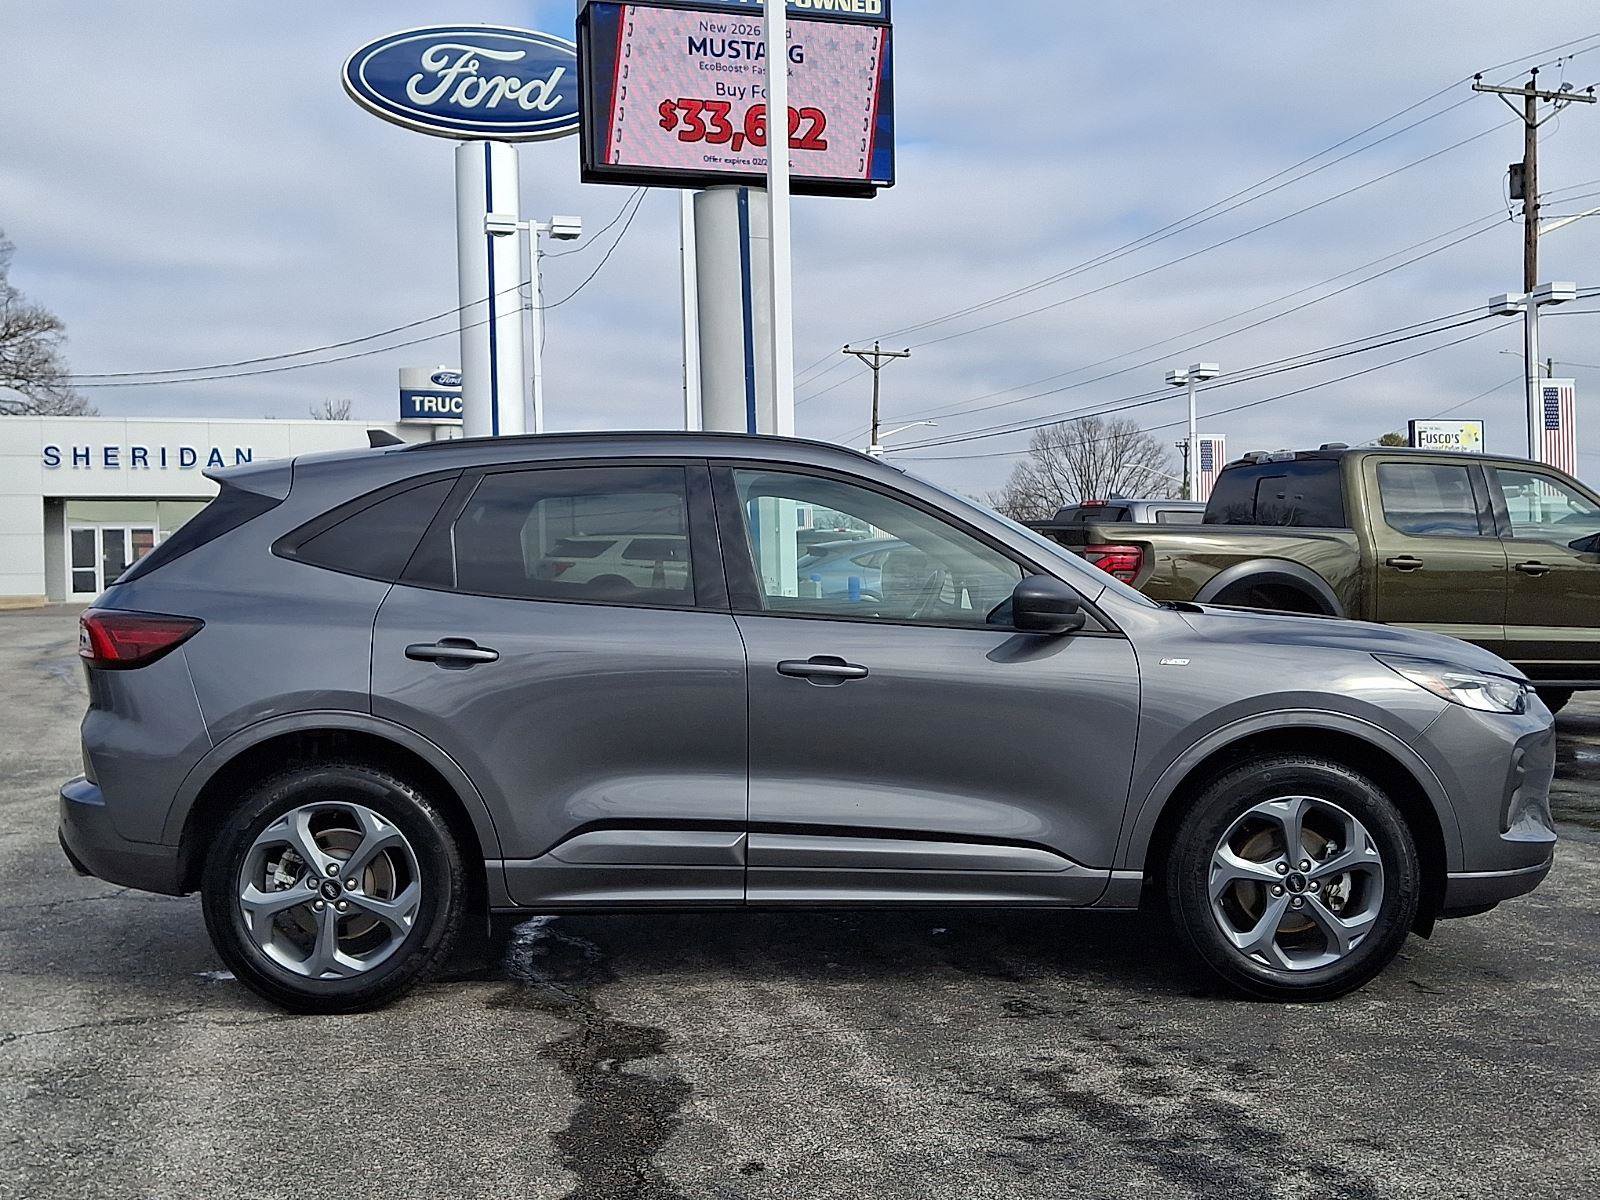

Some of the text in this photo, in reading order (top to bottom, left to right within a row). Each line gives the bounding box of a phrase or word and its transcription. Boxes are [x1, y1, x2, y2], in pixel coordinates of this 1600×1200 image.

[699, 21, 761, 36] New 2026
[688, 36, 804, 63] MUSTAG
[406, 43, 566, 111] Ford
[716, 82, 746, 100] Buy
[703, 155, 721, 163] Offer
[724, 157, 751, 168] expires
[411, 396, 463, 413] TRUC
[43, 446, 253, 468] SHERIDAN
